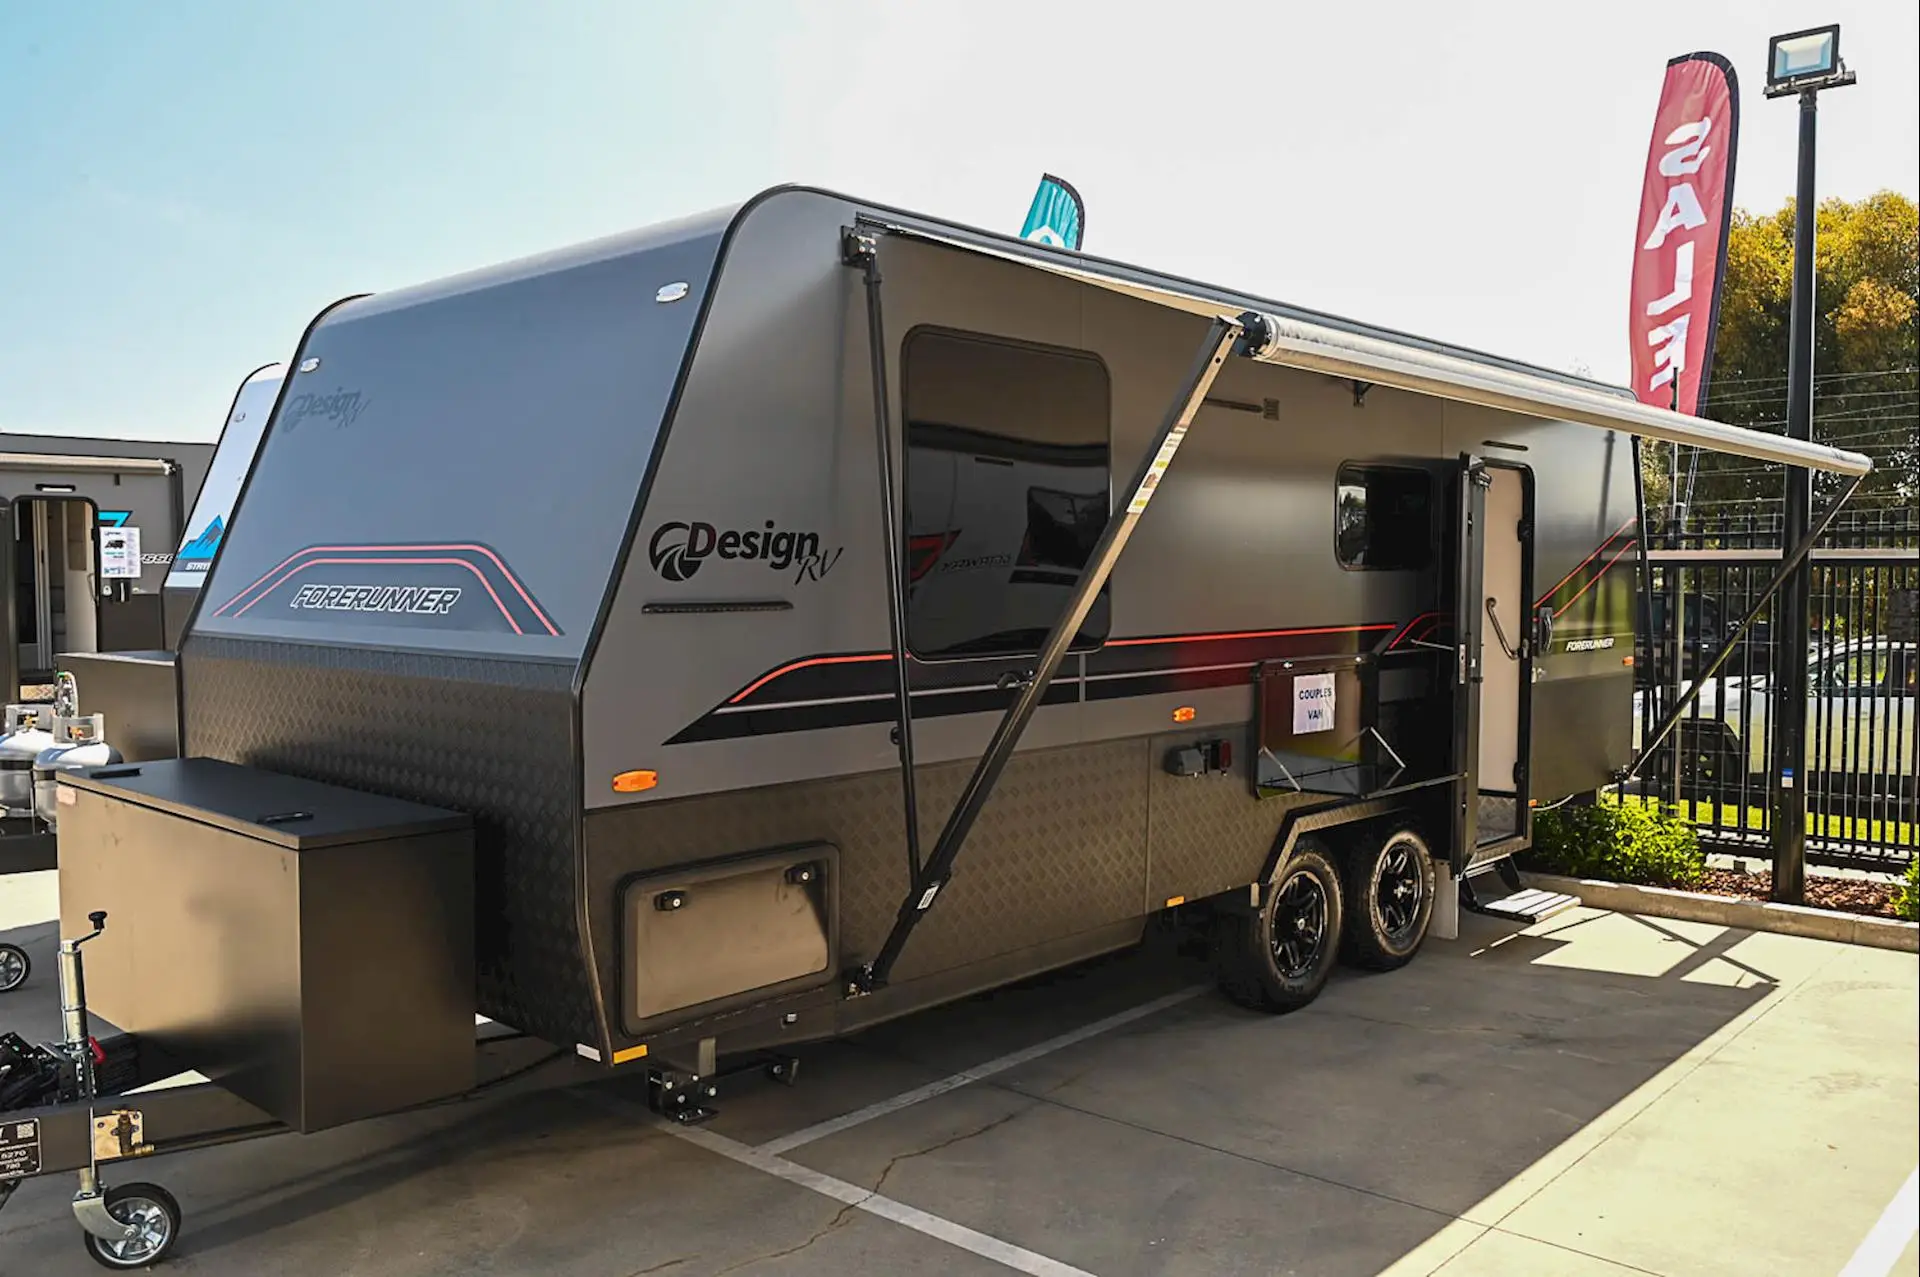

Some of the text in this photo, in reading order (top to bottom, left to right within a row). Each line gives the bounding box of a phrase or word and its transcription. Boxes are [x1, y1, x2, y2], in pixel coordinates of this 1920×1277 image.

[683, 520, 819, 570] Design
[794, 547, 844, 586] RV
[290, 584, 461, 614] FORERUNNER
[1566, 638, 1615, 652] FORERUNNER
[1299, 687, 1332, 700] COUPLES
[1307, 709, 1323, 720] VAN
